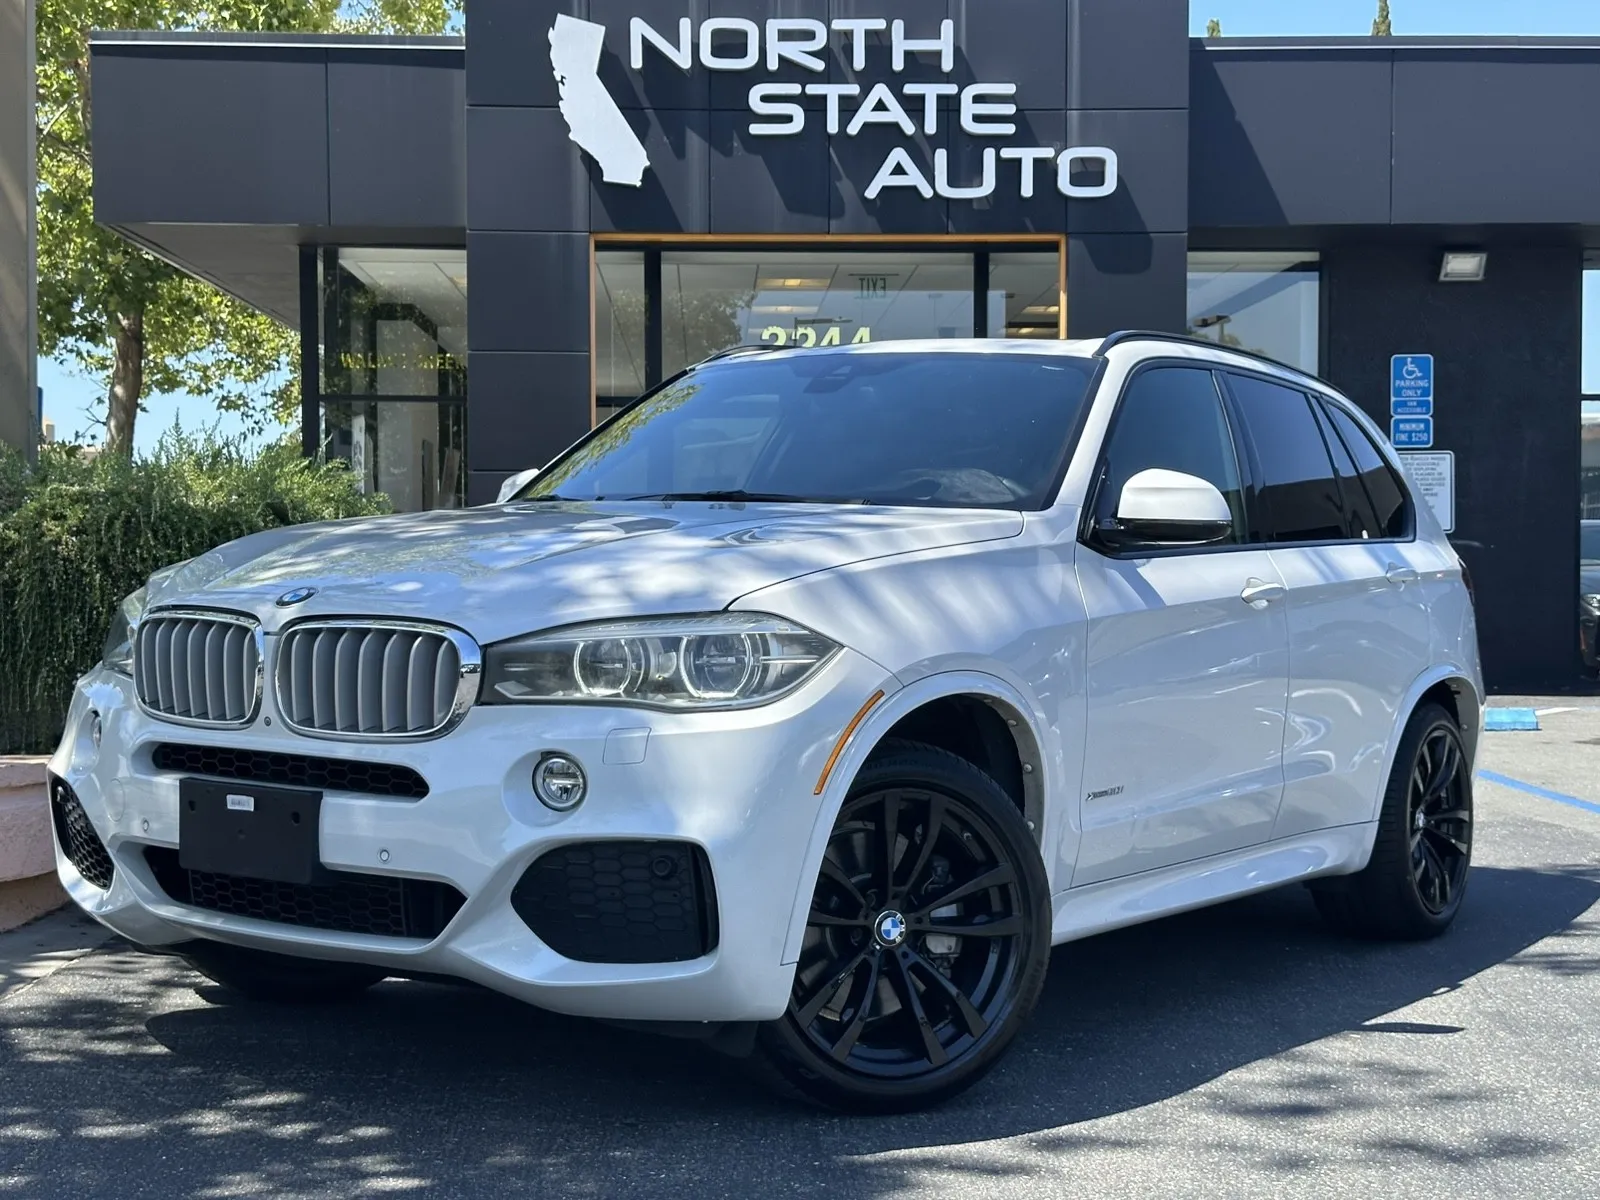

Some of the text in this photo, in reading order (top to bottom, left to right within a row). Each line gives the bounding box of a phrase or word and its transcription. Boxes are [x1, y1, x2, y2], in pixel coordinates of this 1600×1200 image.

[629, 17, 954, 73] NORTH
[748, 82, 1017, 137] STATE
[864, 146, 1119, 200] AUTO
[1395, 380, 1429, 388] PARKING
[1401, 389, 1422, 397] ONLY
[1399, 423, 1425, 431] MINIMUM
[1395, 432, 1428, 442] FINE $250
